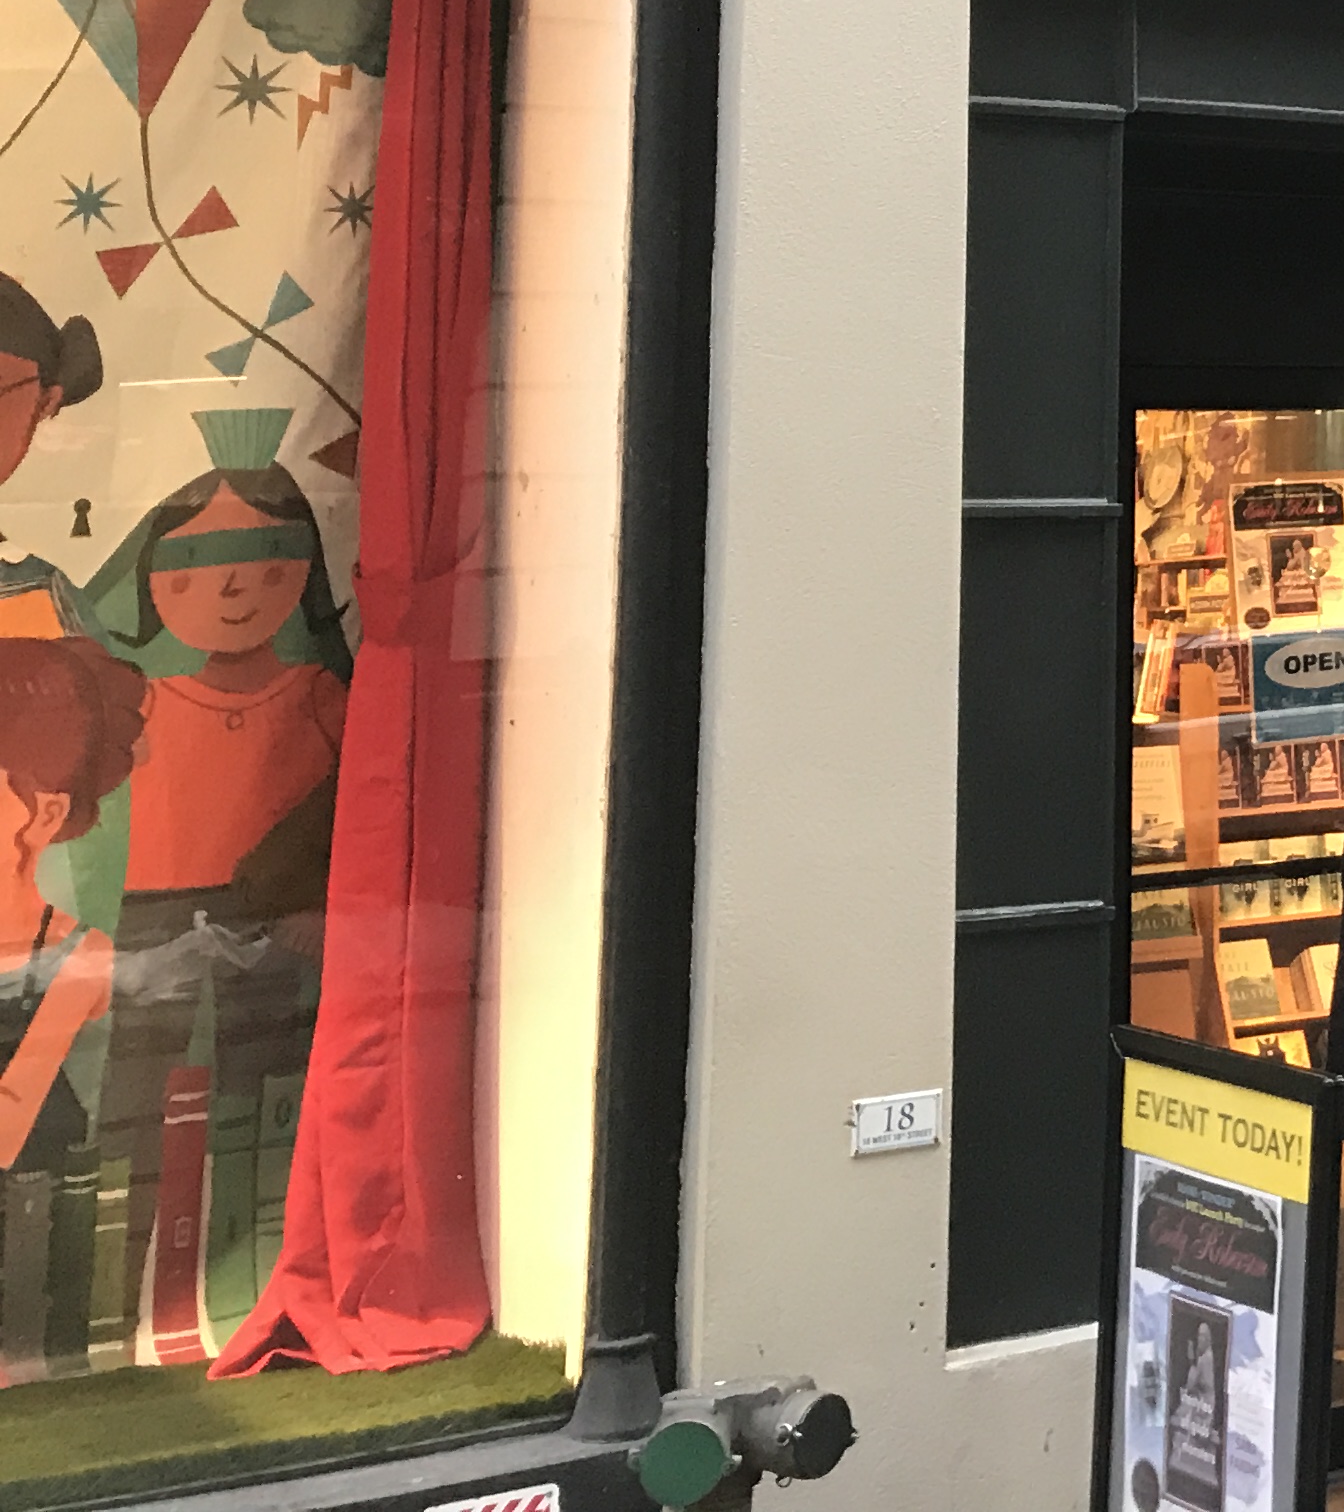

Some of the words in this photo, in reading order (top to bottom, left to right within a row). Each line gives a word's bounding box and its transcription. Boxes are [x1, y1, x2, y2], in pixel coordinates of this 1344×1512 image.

[884, 1102, 914, 1133] 18
[1135, 1089, 1209, 1137] EVENT
[1218, 1112, 1304, 1166] TODAY!
